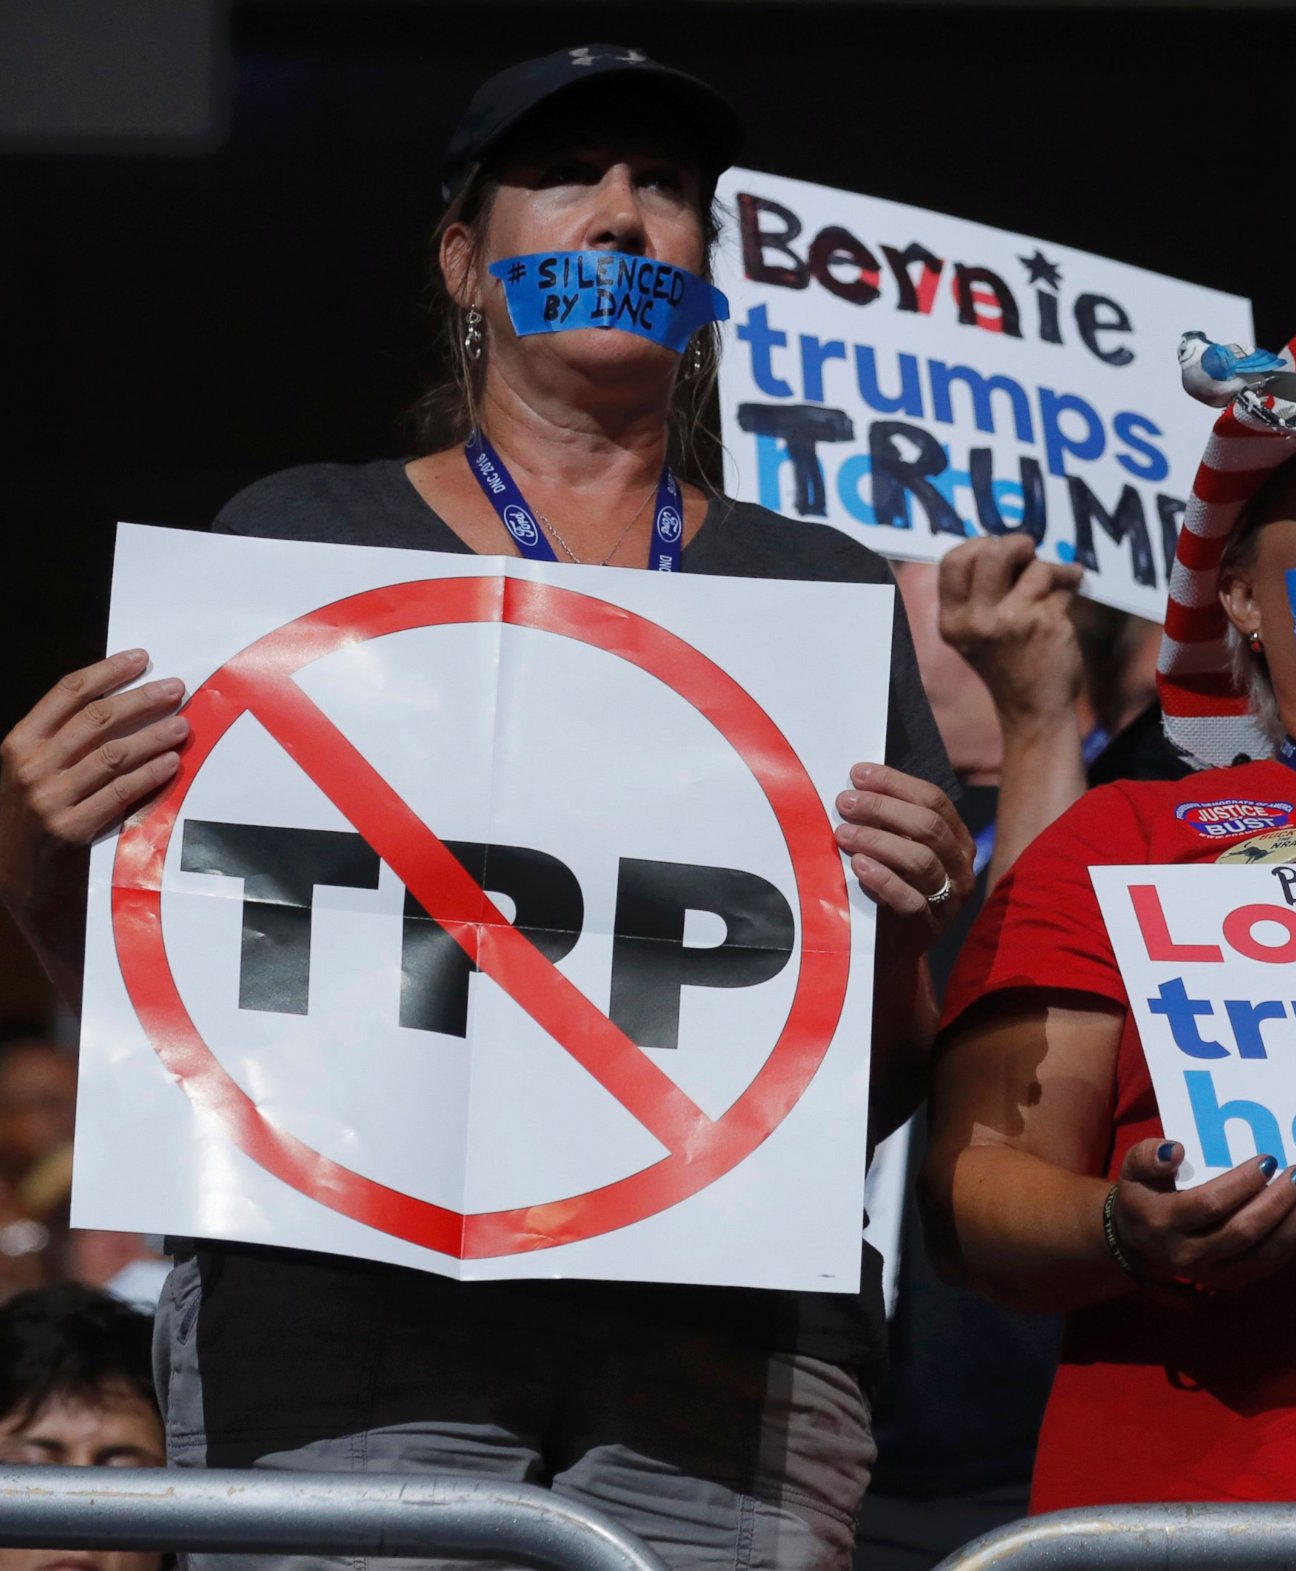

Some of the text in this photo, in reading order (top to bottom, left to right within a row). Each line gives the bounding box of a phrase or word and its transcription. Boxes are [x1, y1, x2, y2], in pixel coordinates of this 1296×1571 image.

[736, 192, 1136, 367] Bernie
[543, 288, 654, 330] BY DNC
[736, 303, 1169, 481] trumps
[1198, 804, 1270, 822] JUSTICE
[1205, 817, 1276, 836] BUST
[1259, 830, 1296, 841] BUCK
[180, 819, 796, 1052] TPP
